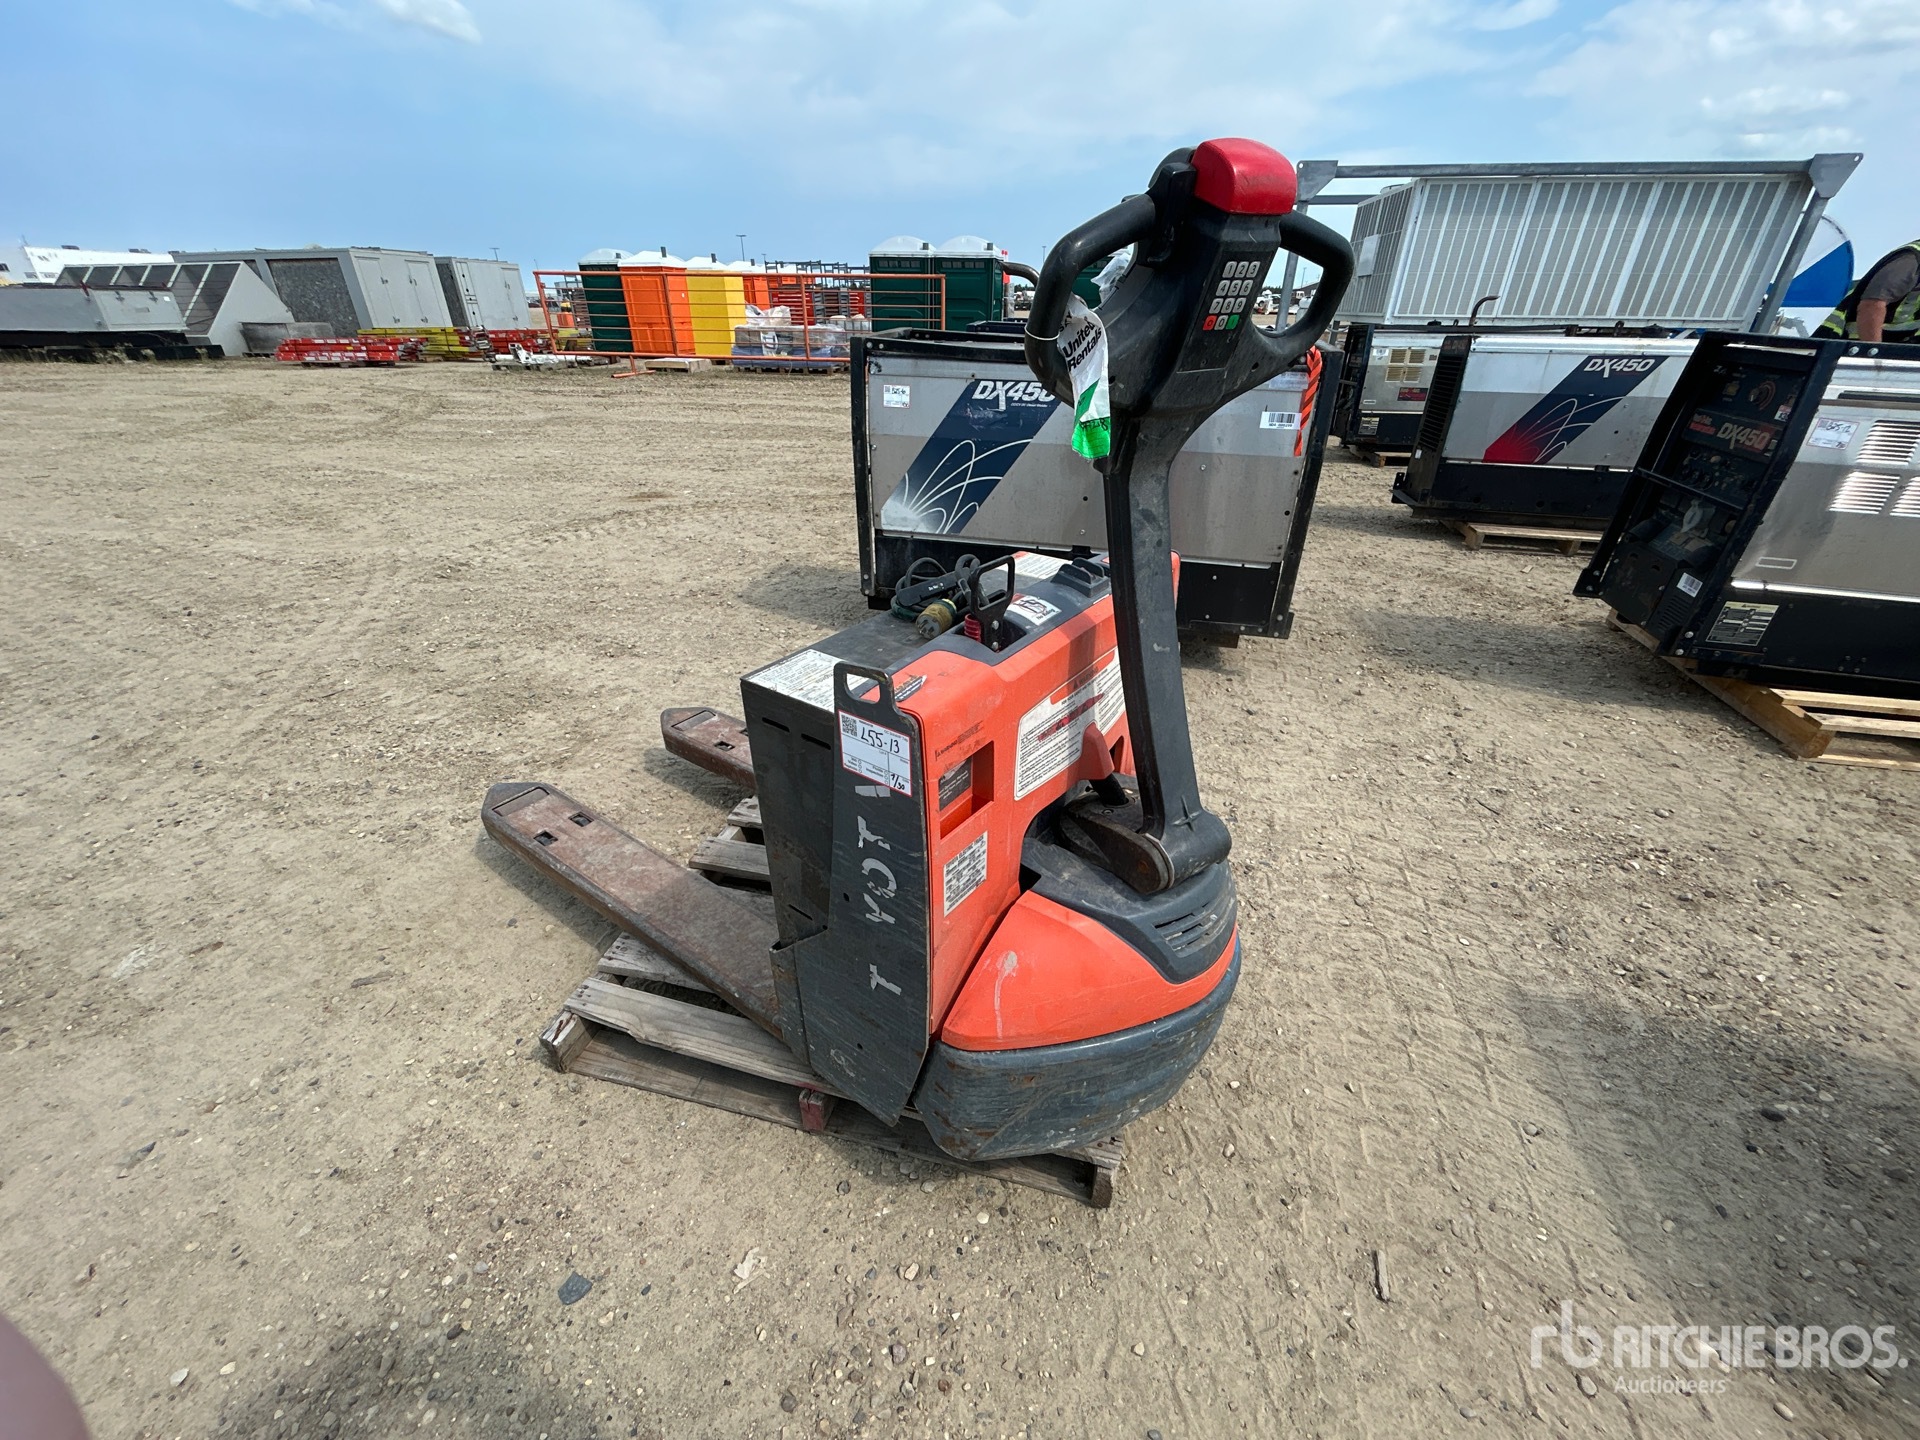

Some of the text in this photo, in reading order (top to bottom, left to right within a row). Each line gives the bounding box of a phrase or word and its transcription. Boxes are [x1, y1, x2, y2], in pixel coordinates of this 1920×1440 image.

[1239, 265, 1245, 274] 2
[1250, 265, 1256, 274] 3
[1232, 284, 1238, 292] 5
[1214, 302, 1242, 310] 7 8 9
[1062, 321, 1096, 358] United
[1067, 327, 1102, 372] Rentals
[1583, 358, 1656, 378] DX450
[1716, 422, 1771, 450] DX450
[861, 727, 900, 754] L55-13
